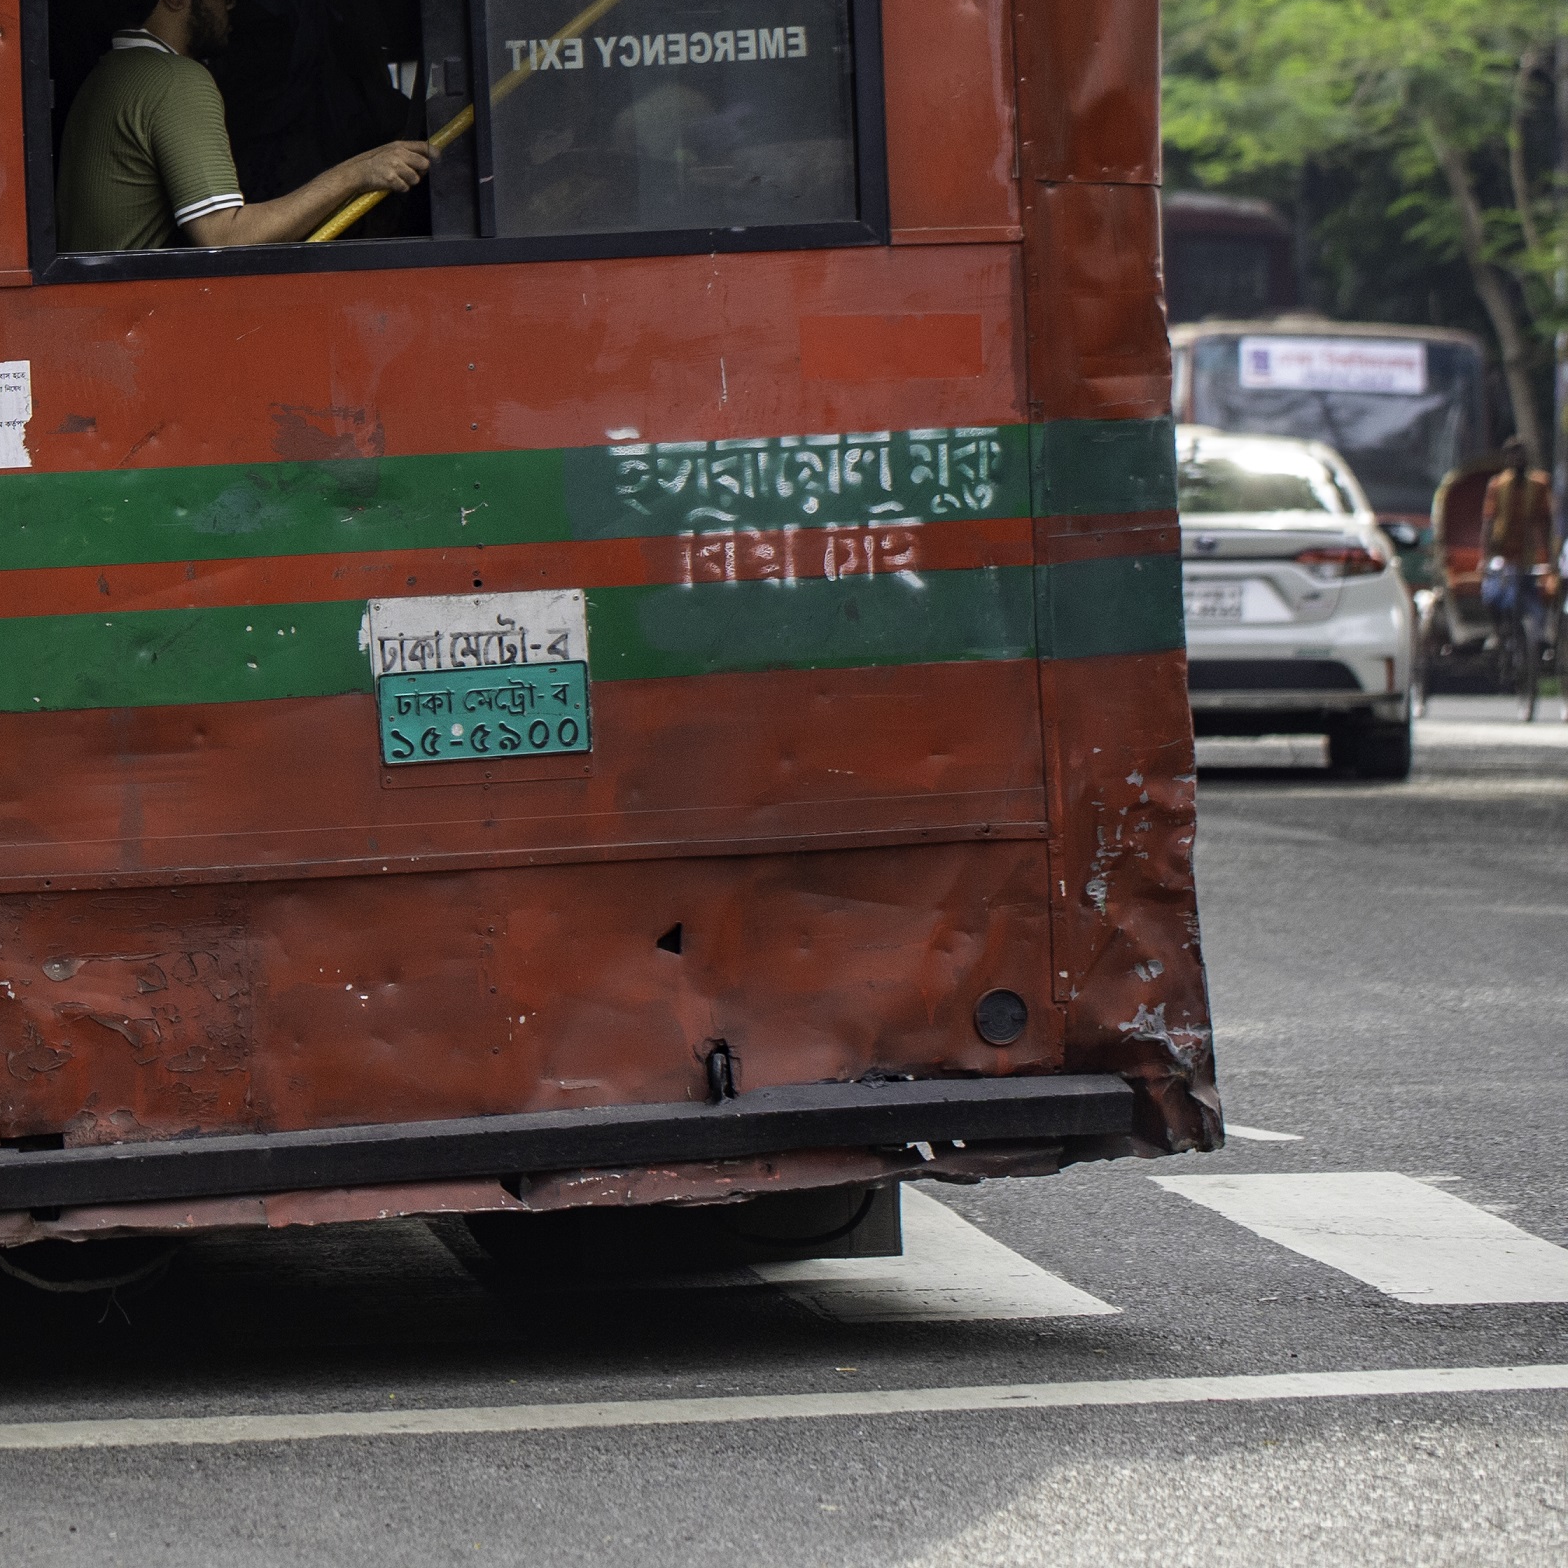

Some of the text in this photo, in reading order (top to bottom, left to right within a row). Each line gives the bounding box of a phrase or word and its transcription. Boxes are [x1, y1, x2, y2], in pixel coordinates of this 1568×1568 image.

[4, 417, 25, 430] কর্তৃপ
[378, 630, 444, 672] ঢাকা
[394, 688, 455, 716] ঢাকা
[391, 717, 579, 759] ১৫-৫৯০০
